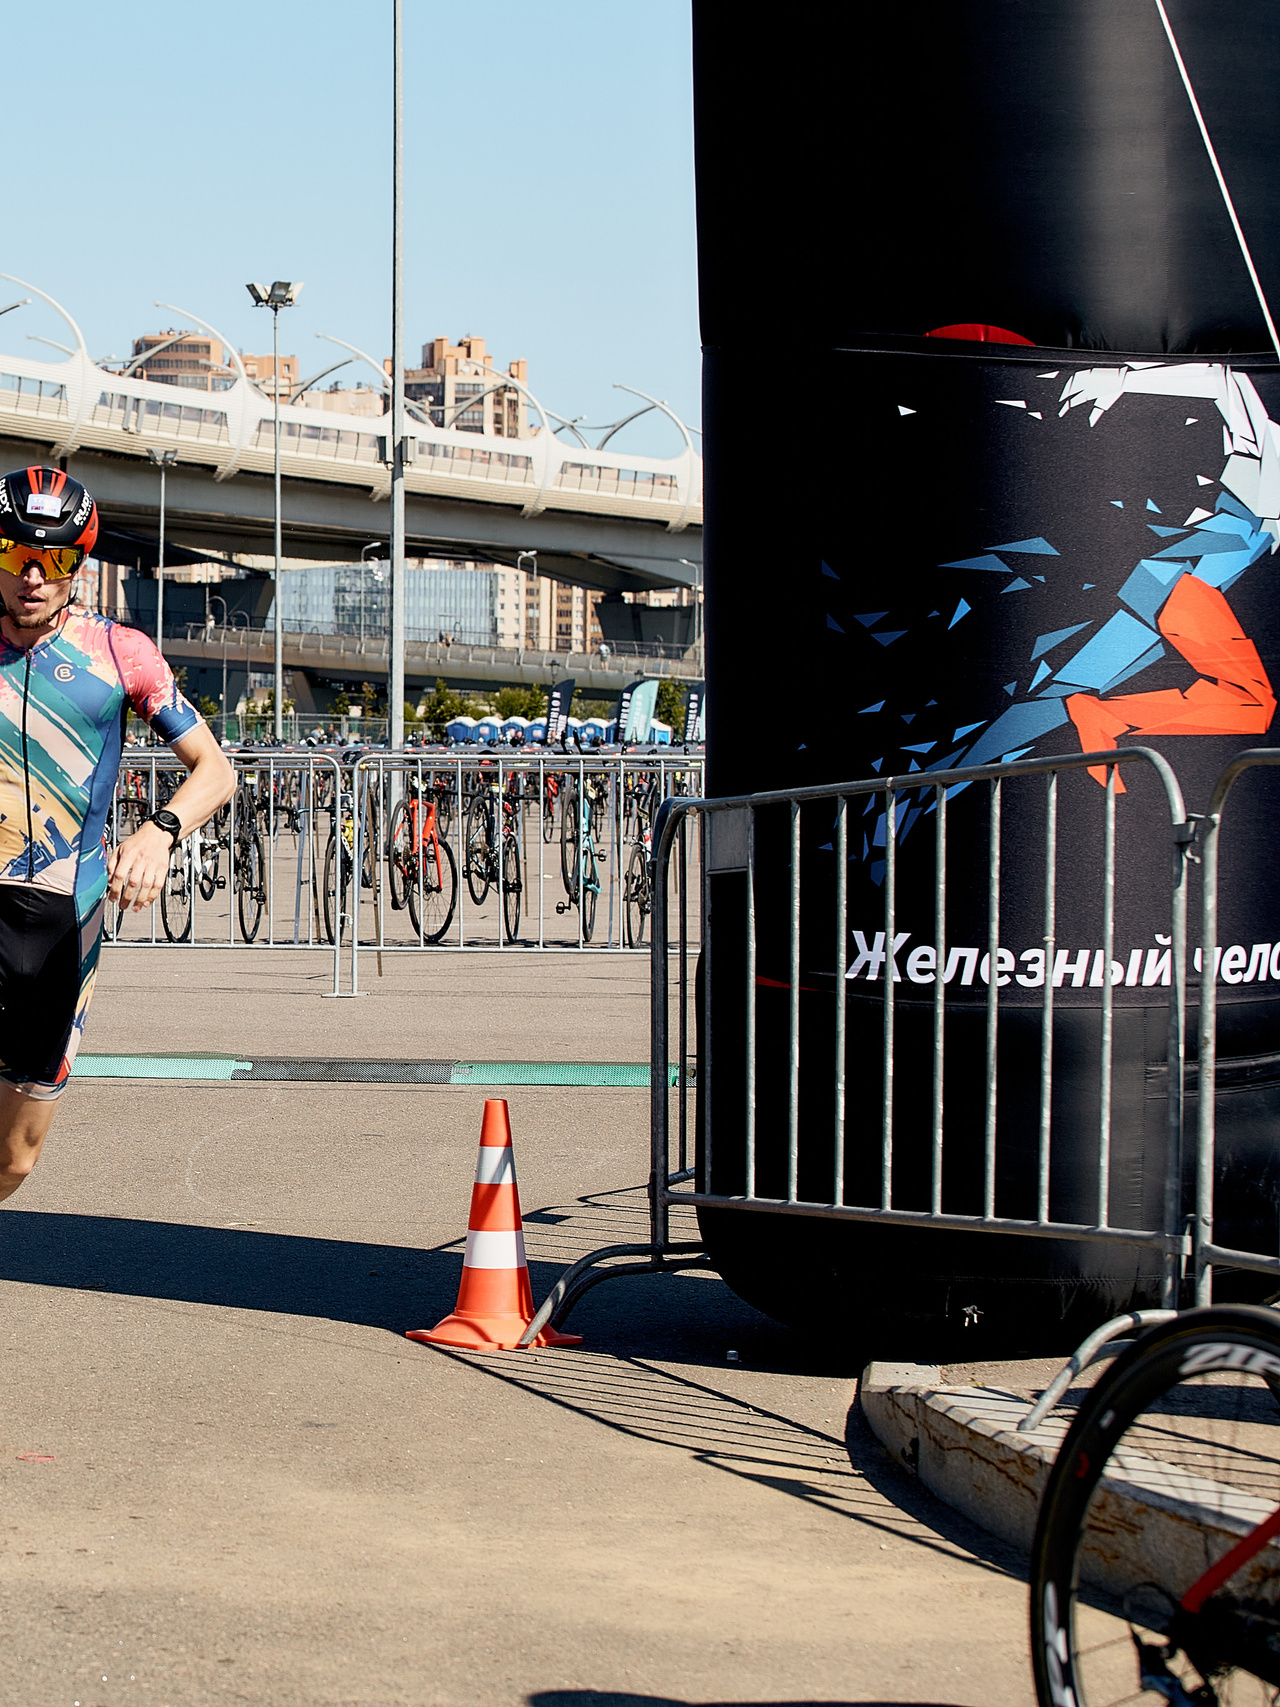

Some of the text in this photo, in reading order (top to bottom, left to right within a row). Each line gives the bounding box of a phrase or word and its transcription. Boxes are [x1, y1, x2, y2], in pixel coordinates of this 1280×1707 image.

[73, 489, 90, 526] RUDY
[547, 691, 562, 737] IATHLON
[845, 930, 1173, 988] Железный
